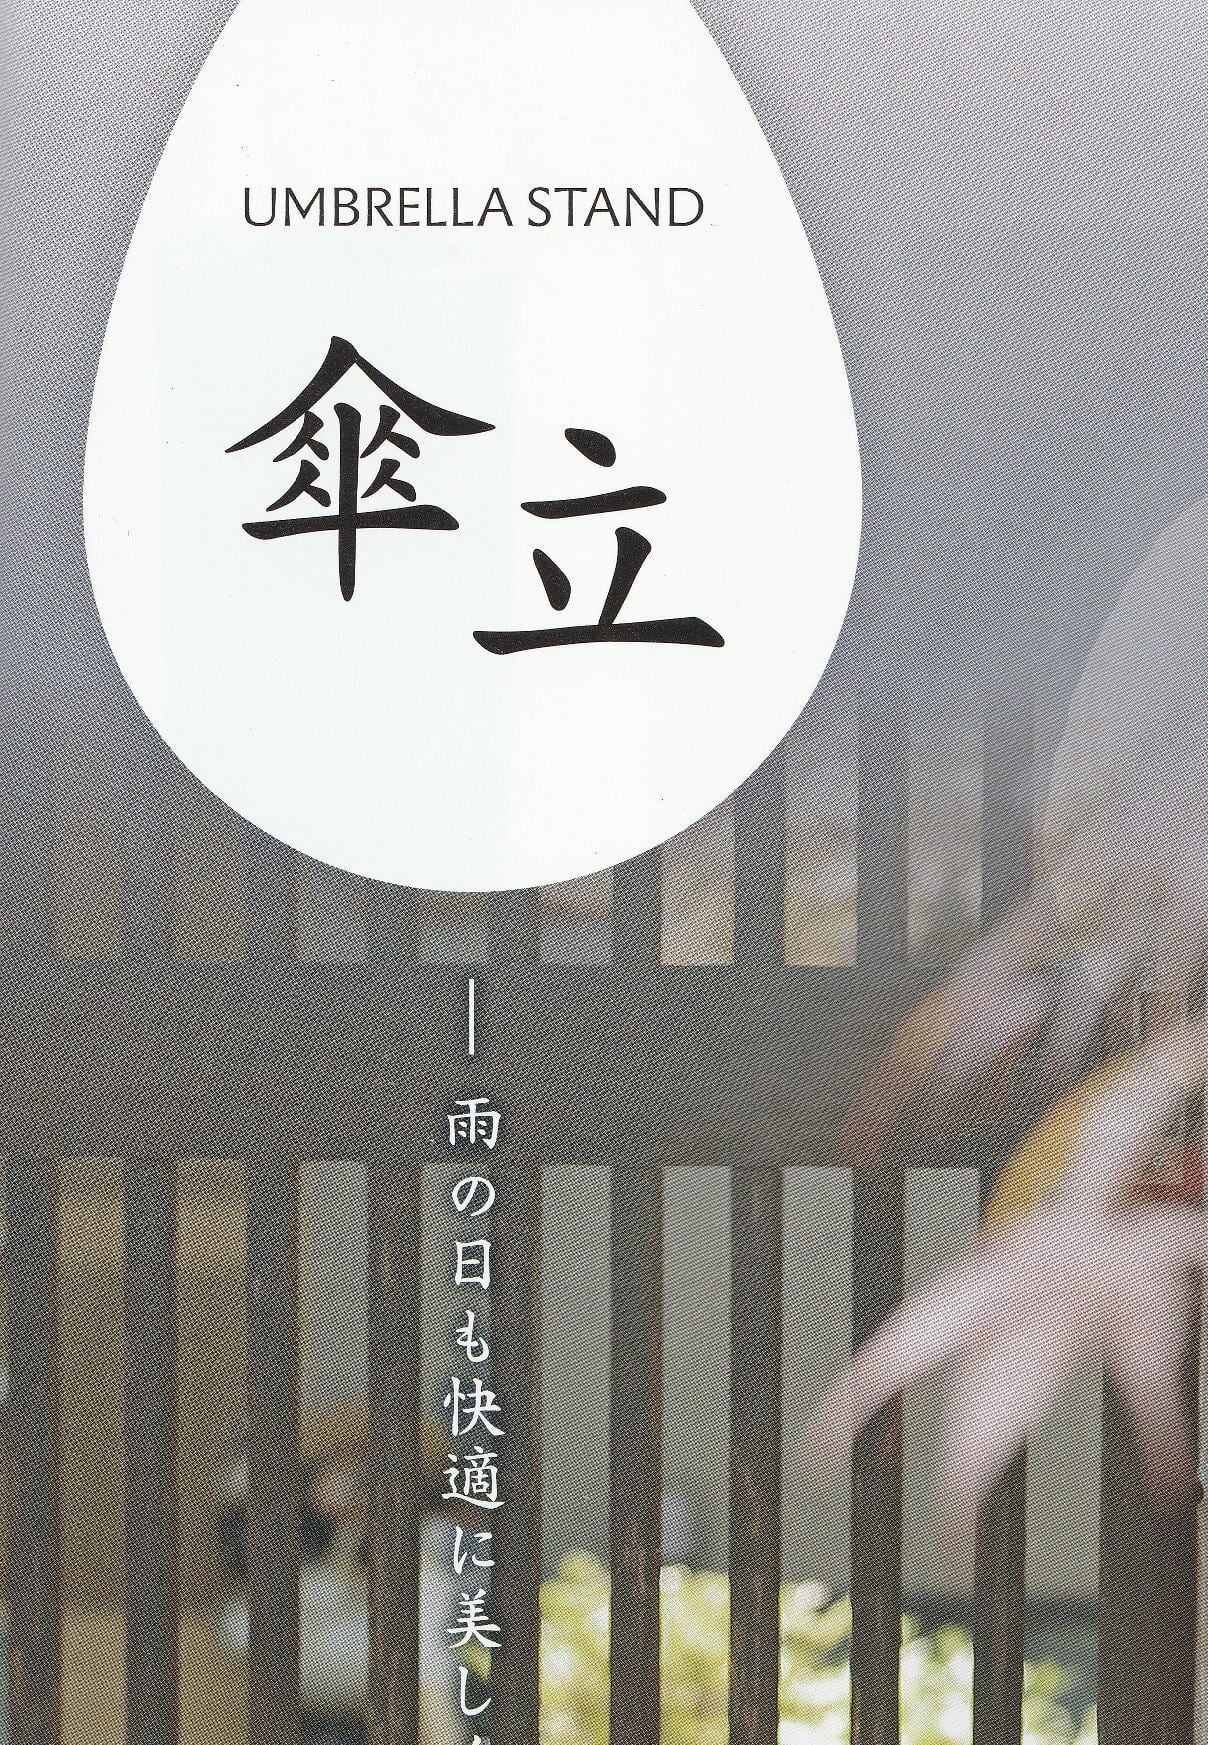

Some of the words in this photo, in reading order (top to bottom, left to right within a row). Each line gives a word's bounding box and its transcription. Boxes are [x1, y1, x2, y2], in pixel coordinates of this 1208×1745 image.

[243, 186, 514, 228] UMBRELLA
[527, 186, 705, 228] STAND
[224, 335, 725, 656] 傘立
